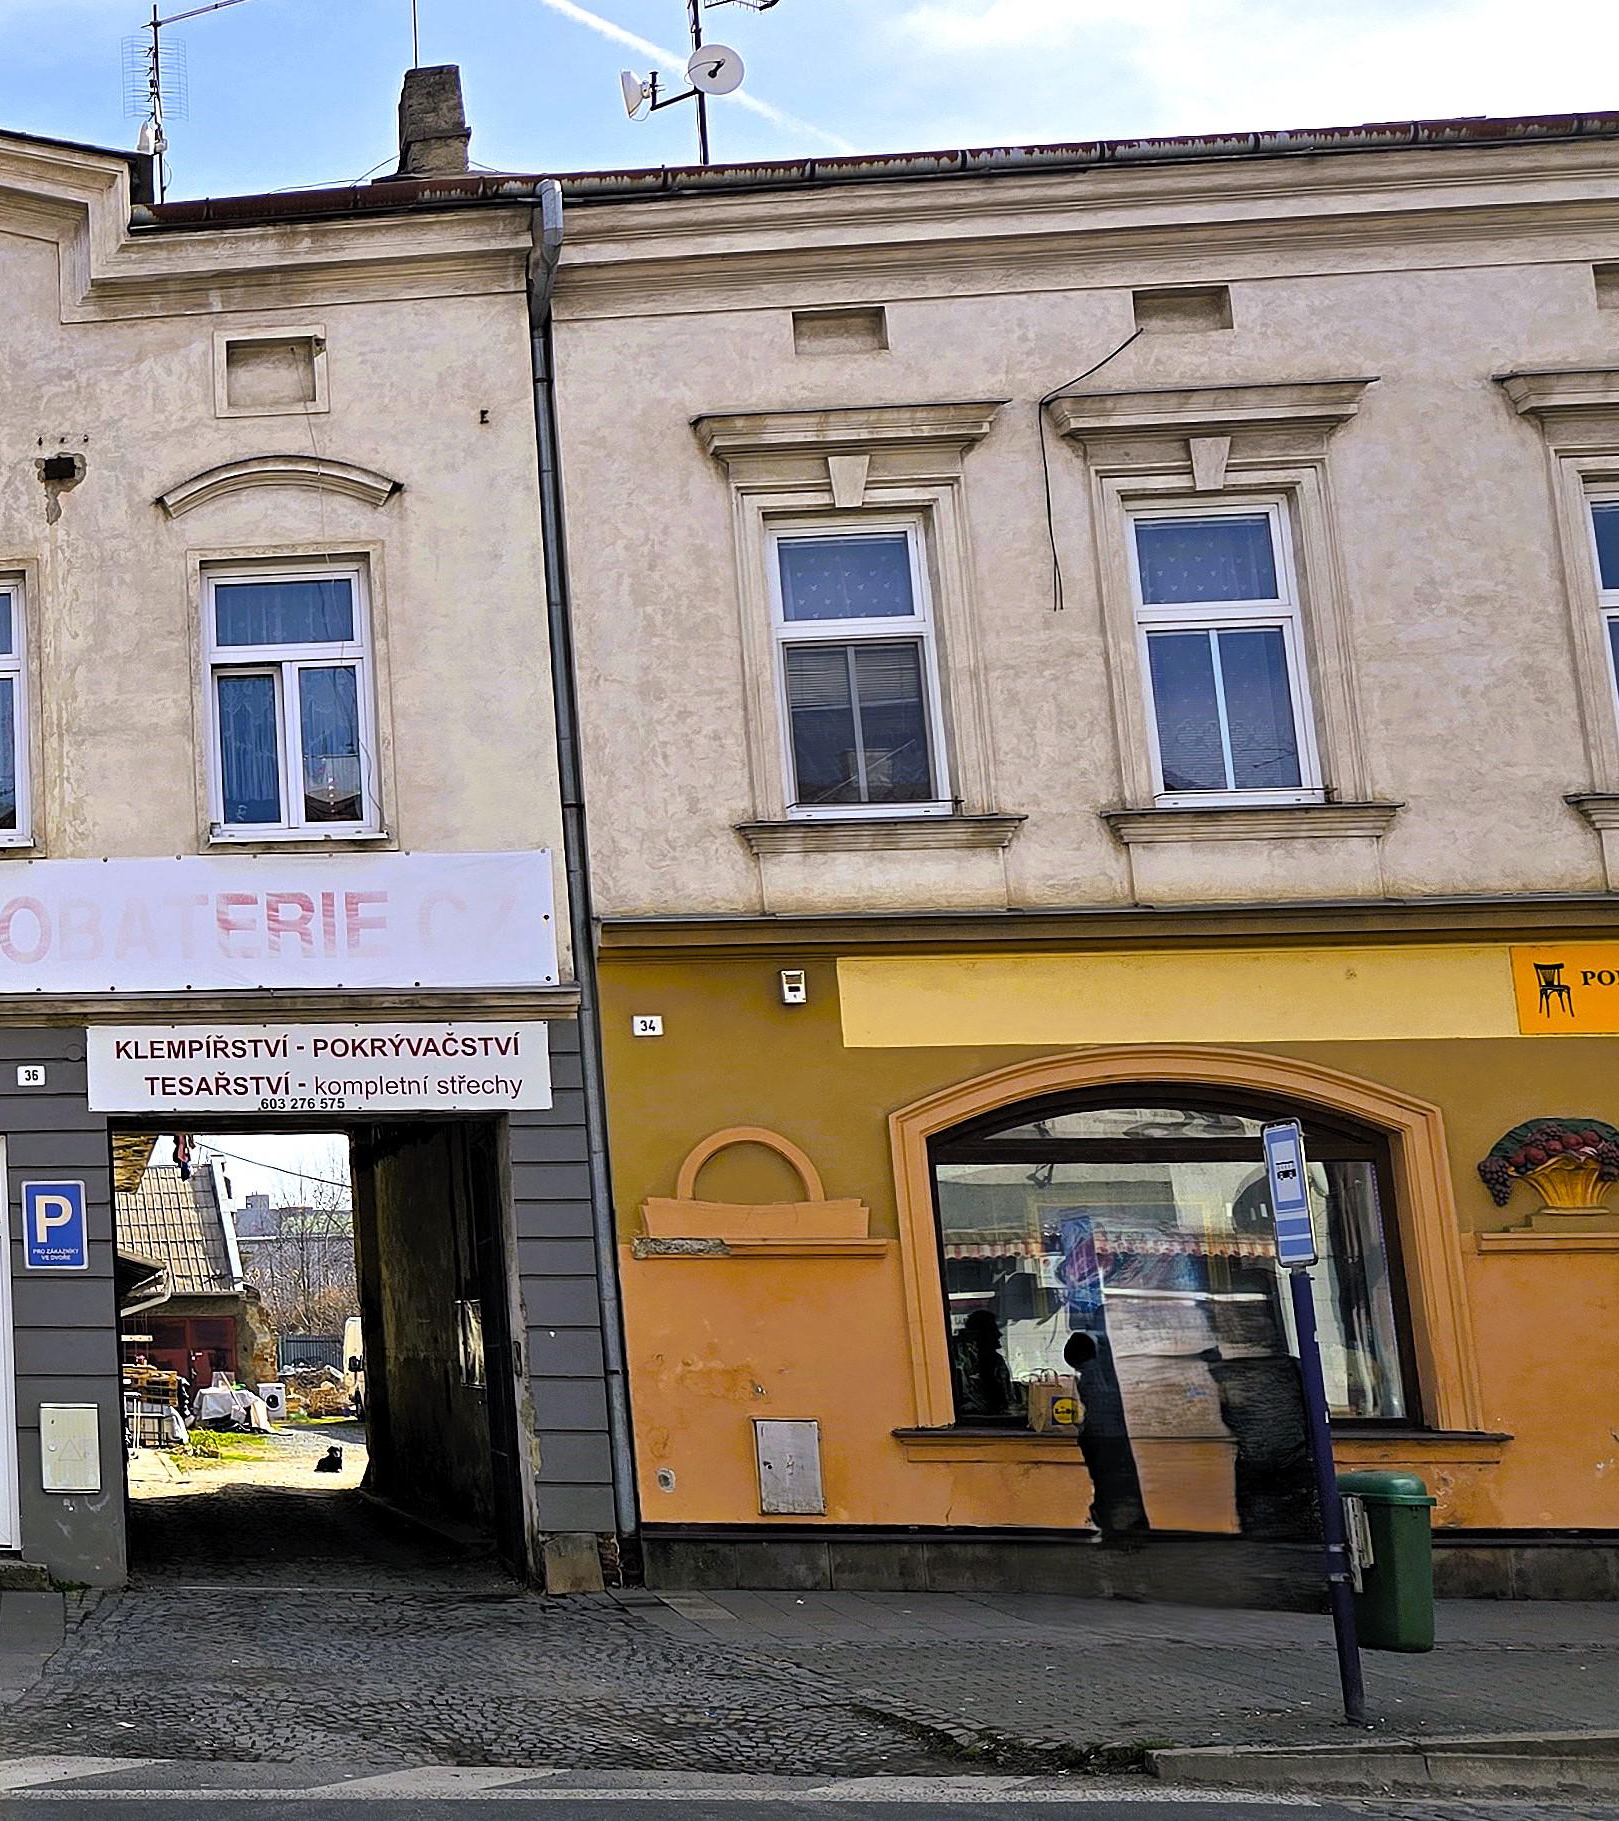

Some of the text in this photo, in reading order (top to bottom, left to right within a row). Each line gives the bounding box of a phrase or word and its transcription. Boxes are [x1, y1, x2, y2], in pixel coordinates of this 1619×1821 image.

[640, 1019, 656, 1032] 34
[115, 1034, 288, 1059] KLEMPÍŘSTVÍ
[313, 1032, 519, 1058] POKRÝVAČSTVÍ
[24, 1069, 39, 1081] 36
[145, 1071, 290, 1096] TESAŘSTVÍ
[315, 1074, 429, 1099] kompletní
[436, 1073, 523, 1100] střechy
[260, 1098, 345, 1109] 603 276 575
[35, 1195, 73, 1243] P
